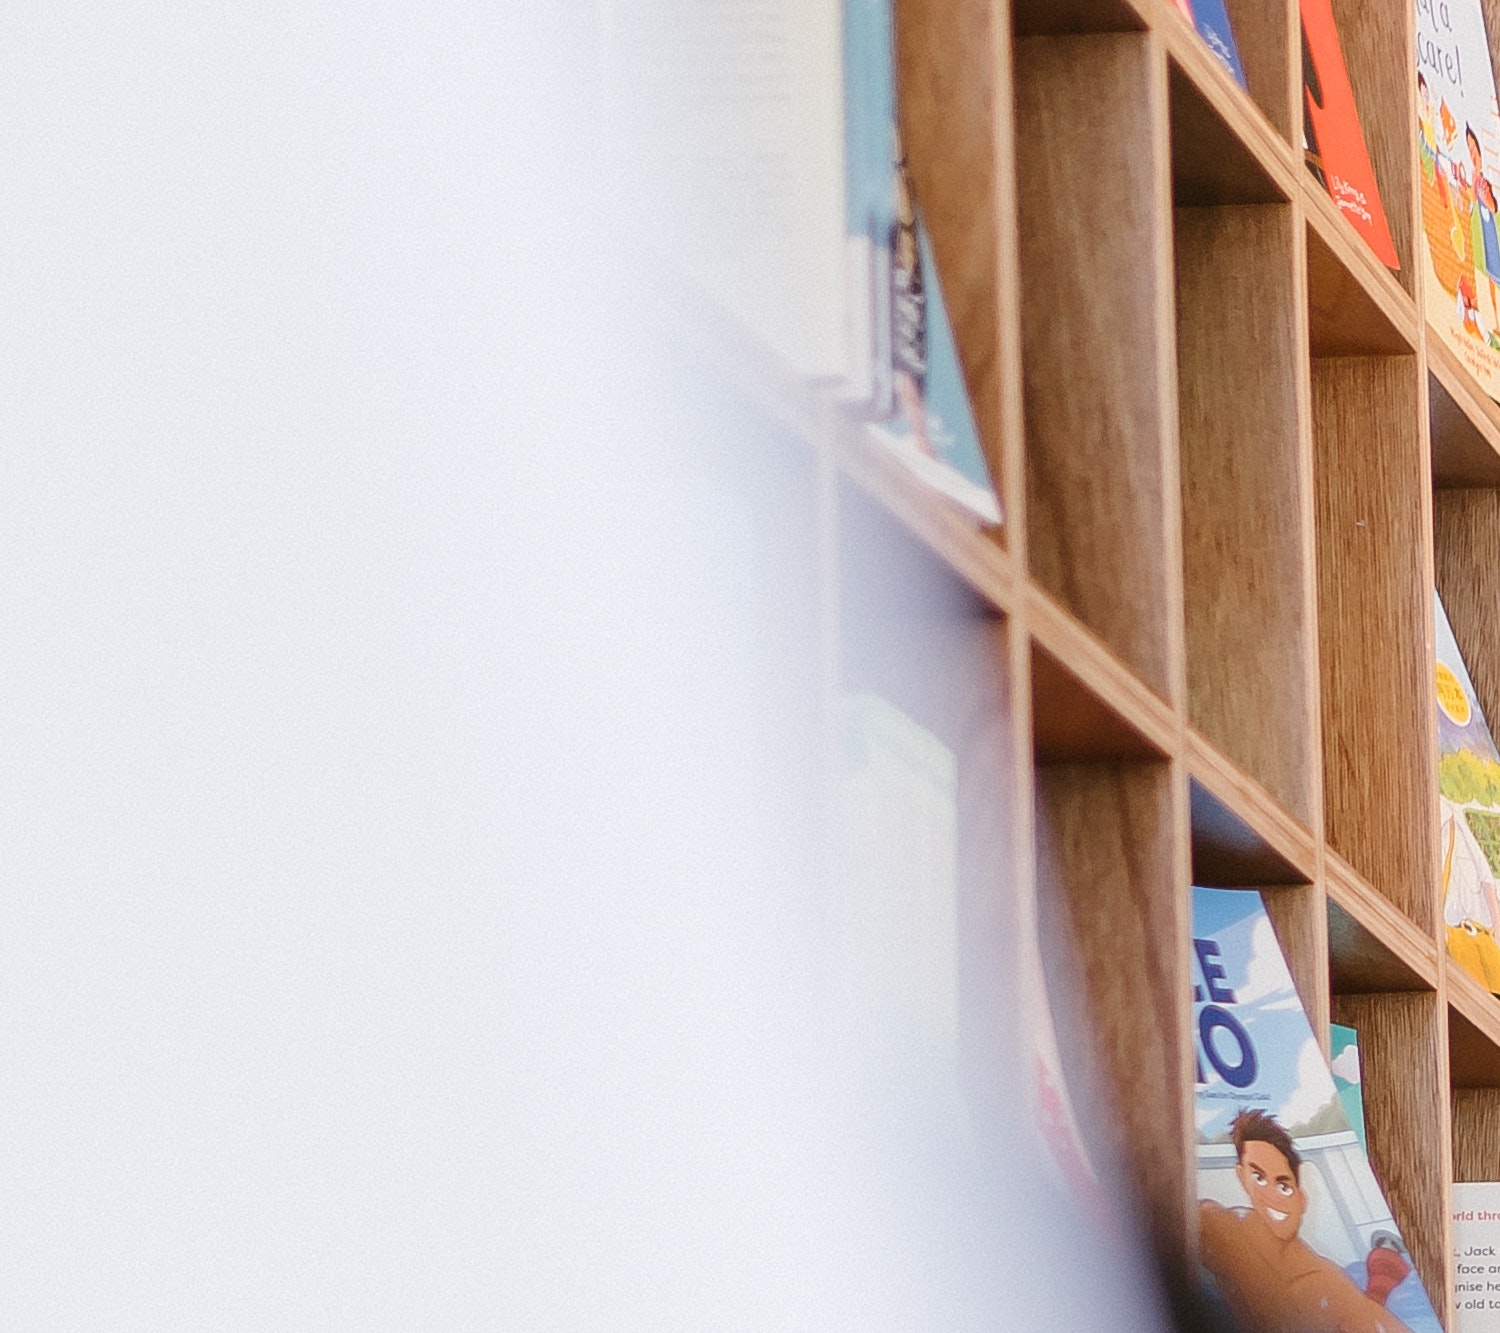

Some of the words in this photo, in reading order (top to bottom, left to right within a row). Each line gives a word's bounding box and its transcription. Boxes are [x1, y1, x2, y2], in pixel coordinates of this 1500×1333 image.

[1417, 32, 1464, 98] care!
[1193, 938, 1239, 1004] E
[1193, 1004, 1259, 1089] O
[1457, 1264, 1485, 1274] face
[1464, 1246, 1496, 1256] Jack
[1465, 1299, 1485, 1310] old
